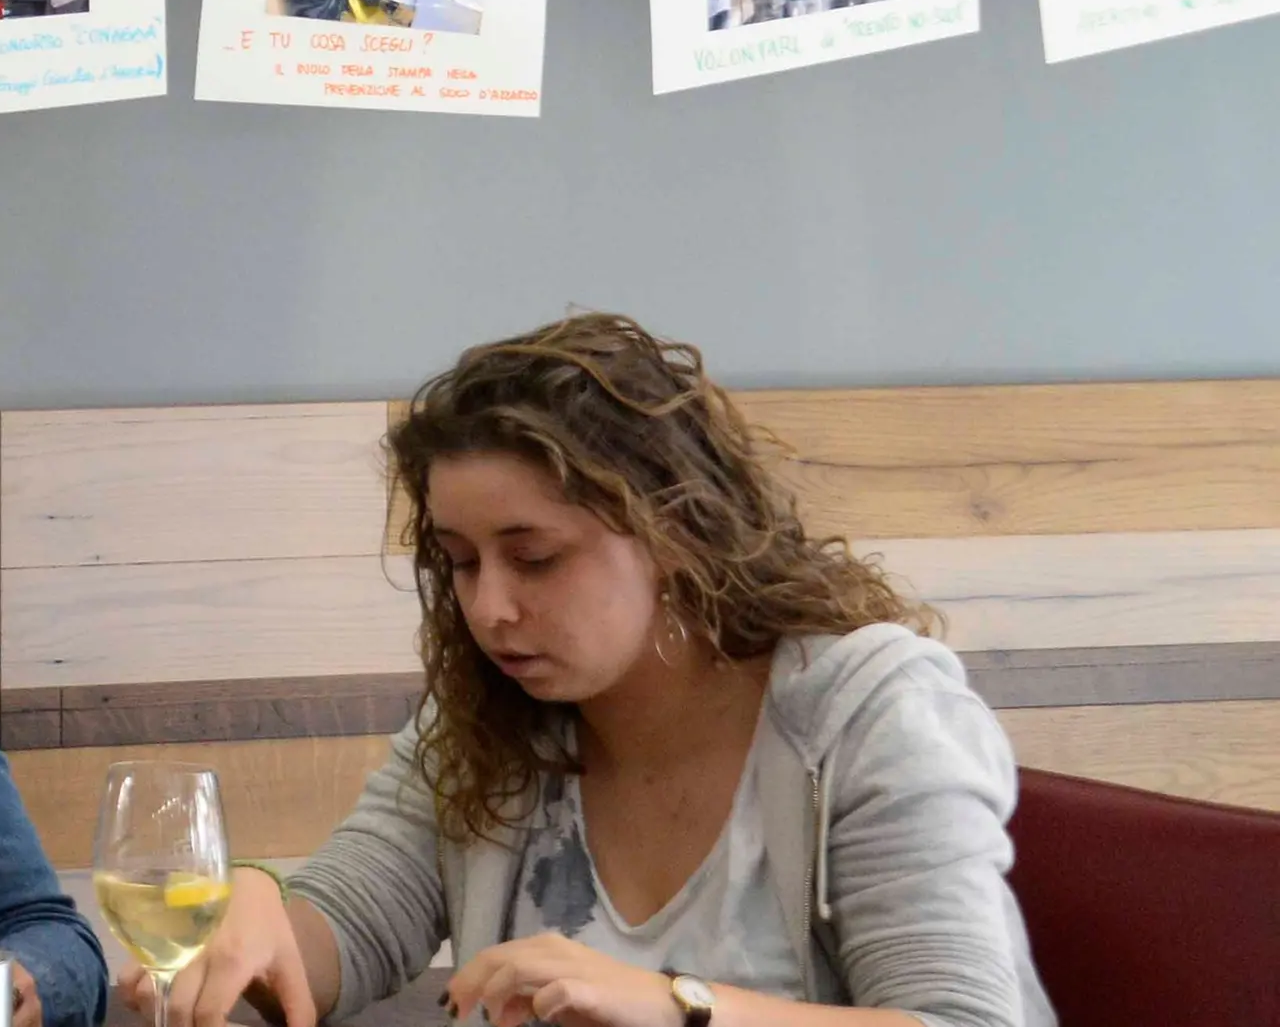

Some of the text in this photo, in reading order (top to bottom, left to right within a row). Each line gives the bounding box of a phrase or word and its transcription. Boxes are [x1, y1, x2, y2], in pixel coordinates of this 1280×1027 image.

[269, 32, 291, 49] TU
[310, 33, 346, 52] COSA
[360, 34, 413, 53] SCEGLI
